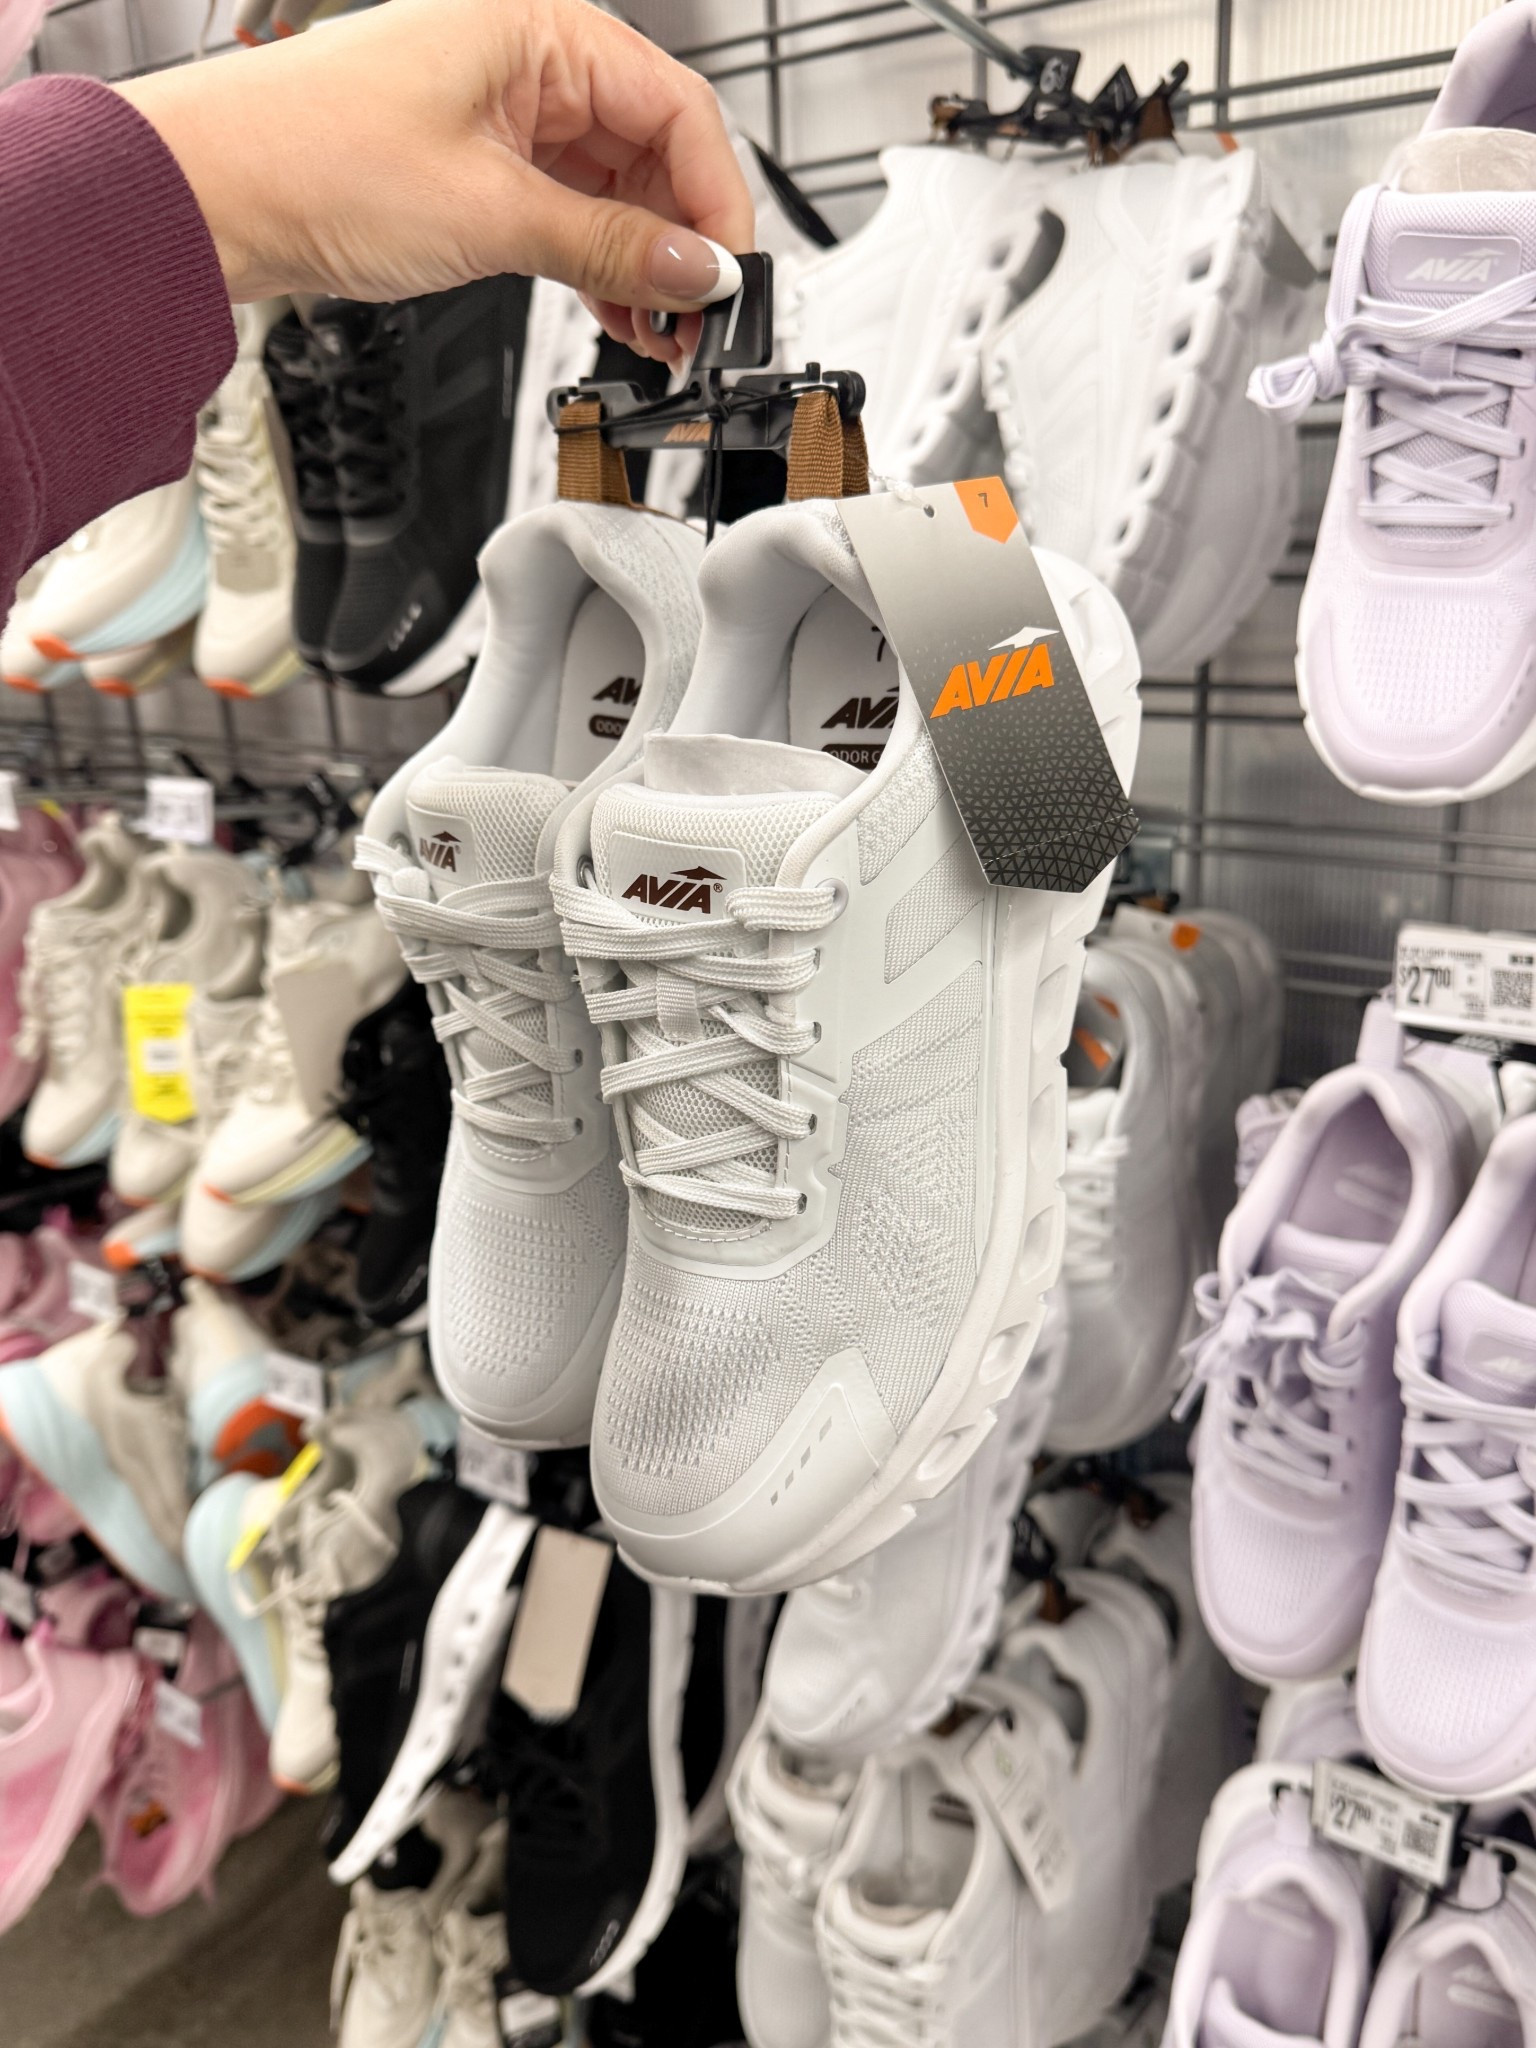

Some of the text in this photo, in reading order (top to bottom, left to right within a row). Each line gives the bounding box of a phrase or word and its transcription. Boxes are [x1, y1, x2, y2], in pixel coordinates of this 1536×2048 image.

[1405, 258, 1492, 282] AVIA
[977, 492, 988, 508] 7
[929, 643, 1055, 719] AVIA
